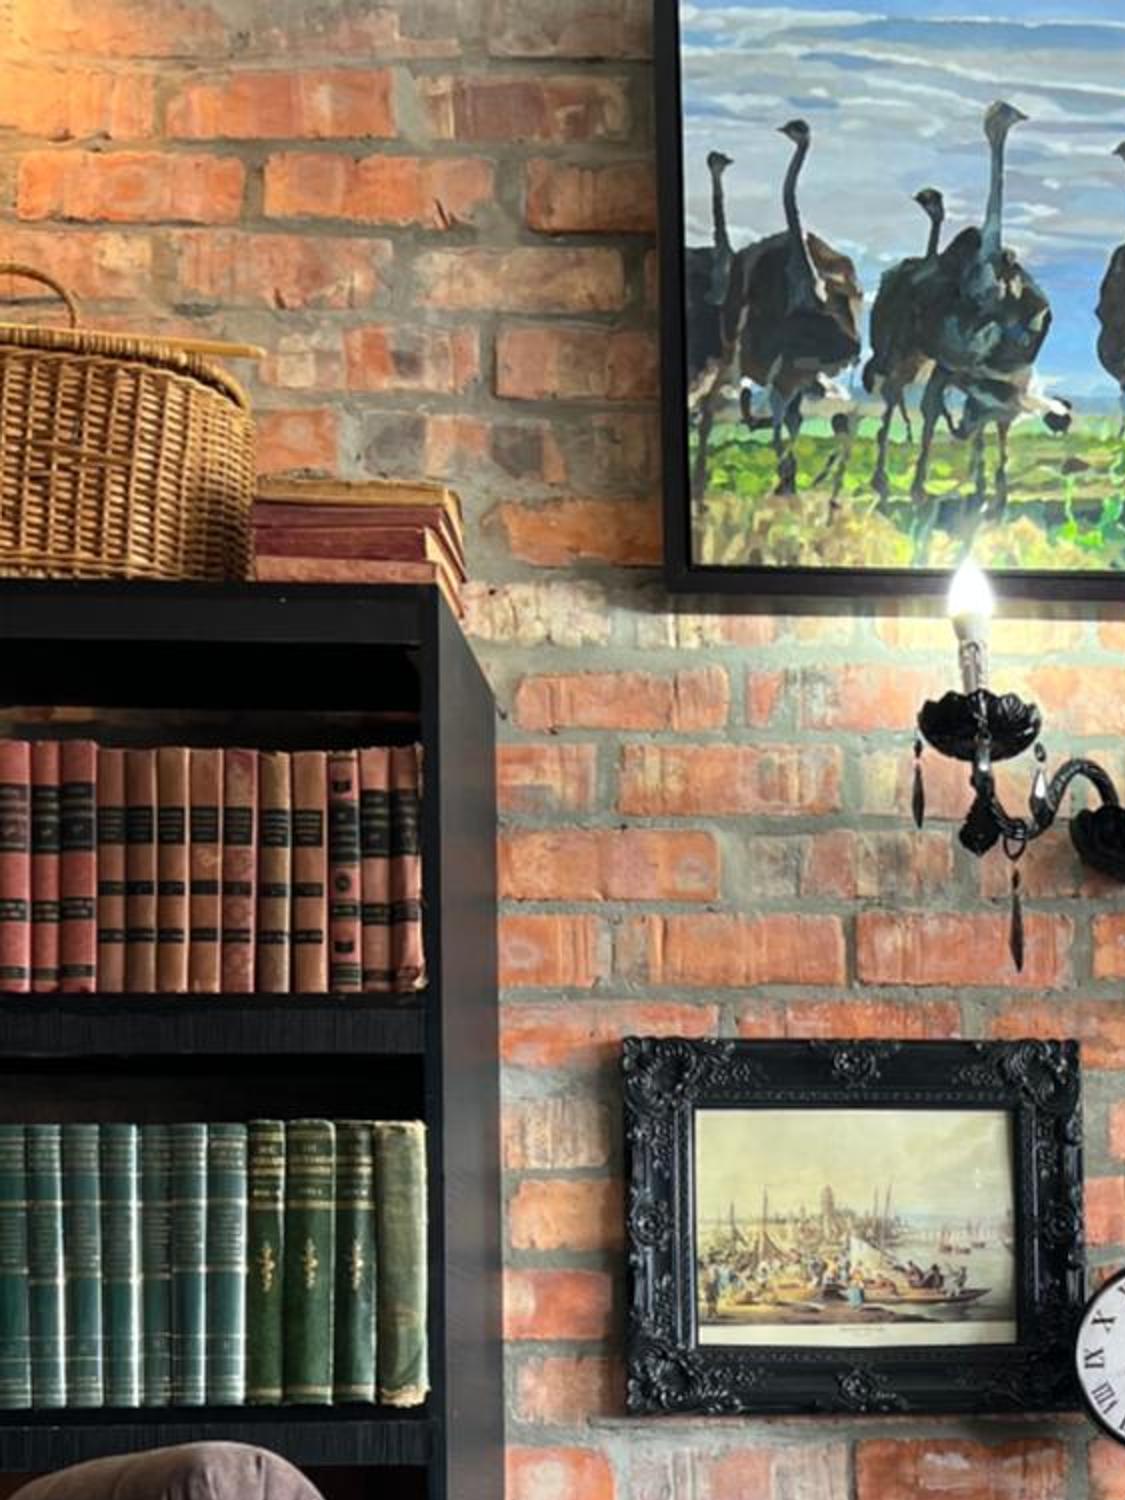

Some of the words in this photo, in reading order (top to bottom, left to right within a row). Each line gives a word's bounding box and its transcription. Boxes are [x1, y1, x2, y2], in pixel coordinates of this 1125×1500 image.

[1091, 1309, 1117, 1333] X
[1083, 1348, 1105, 1370] IX
[1091, 1381, 1121, 1415] VIII
